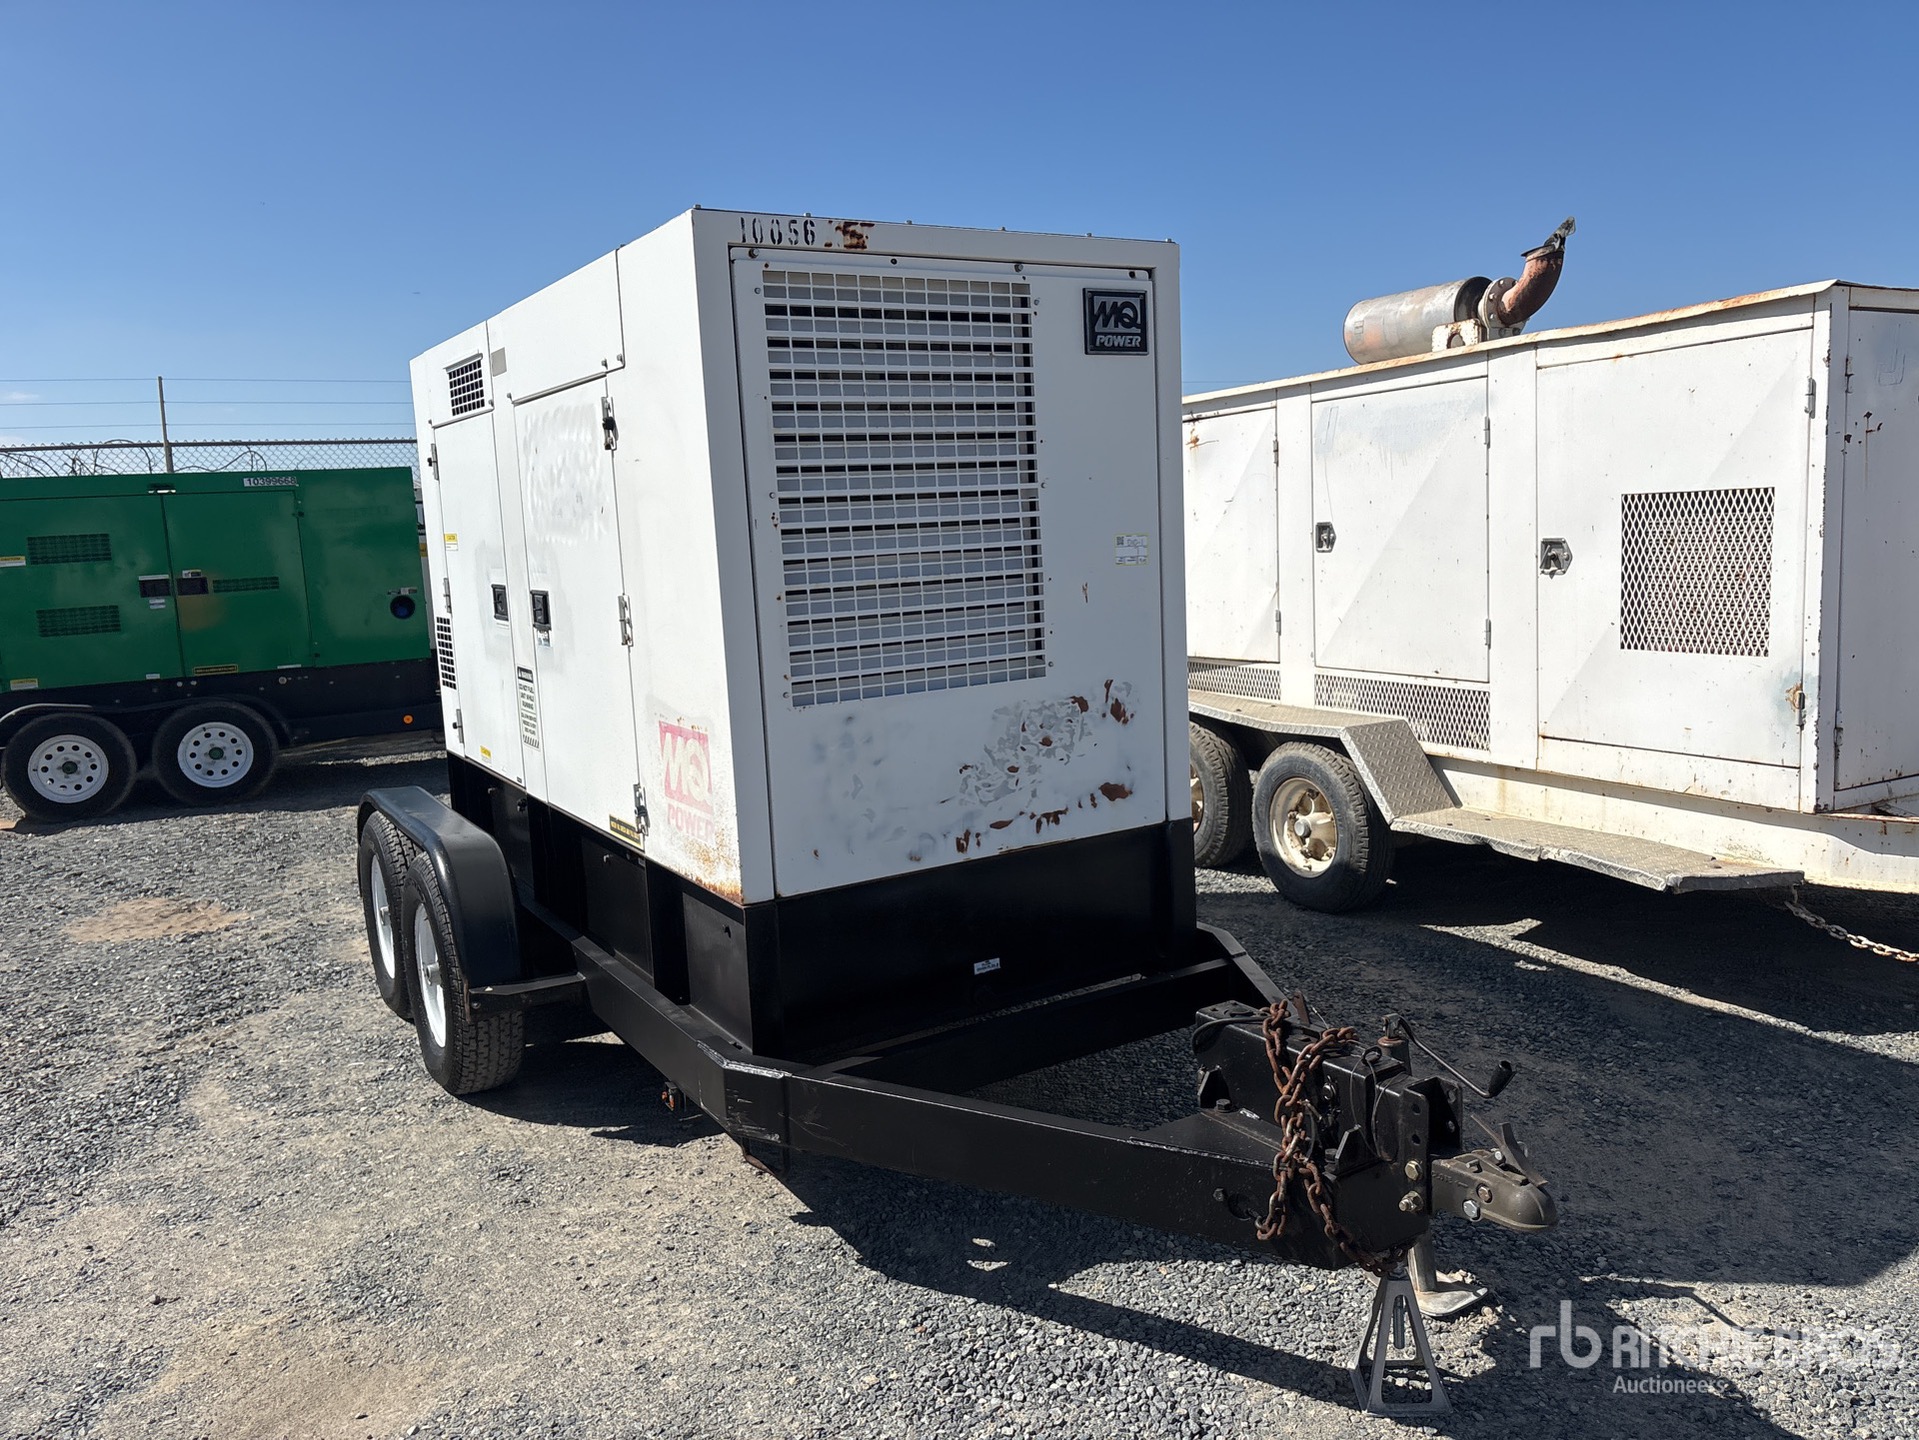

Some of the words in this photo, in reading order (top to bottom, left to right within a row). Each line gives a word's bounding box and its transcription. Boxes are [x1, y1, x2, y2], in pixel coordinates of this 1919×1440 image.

[740, 216, 816, 246] 10056
[1094, 299, 1141, 330] MQ
[1095, 334, 1142, 348] POWER
[661, 730, 713, 805] MQ
[667, 803, 715, 844] POWER
